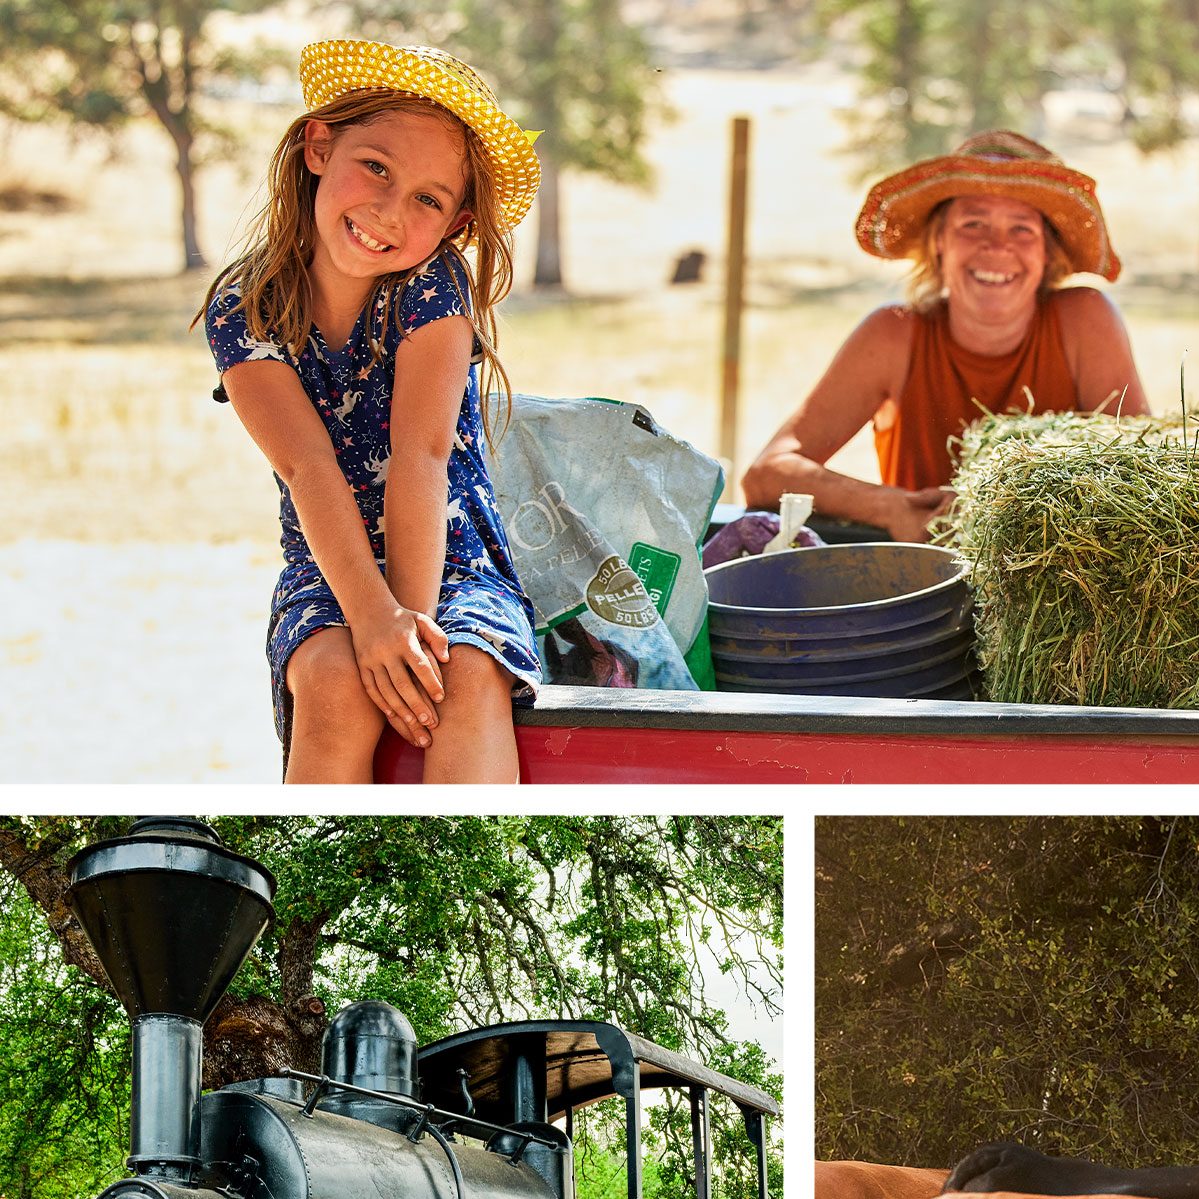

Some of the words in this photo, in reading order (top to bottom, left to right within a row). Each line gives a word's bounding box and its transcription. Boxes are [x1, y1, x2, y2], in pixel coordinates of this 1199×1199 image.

[598, 569, 611, 585] 50
[638, 556, 652, 587] ETS
[616, 611, 631, 623] 50
[633, 606, 656, 625] LBS
